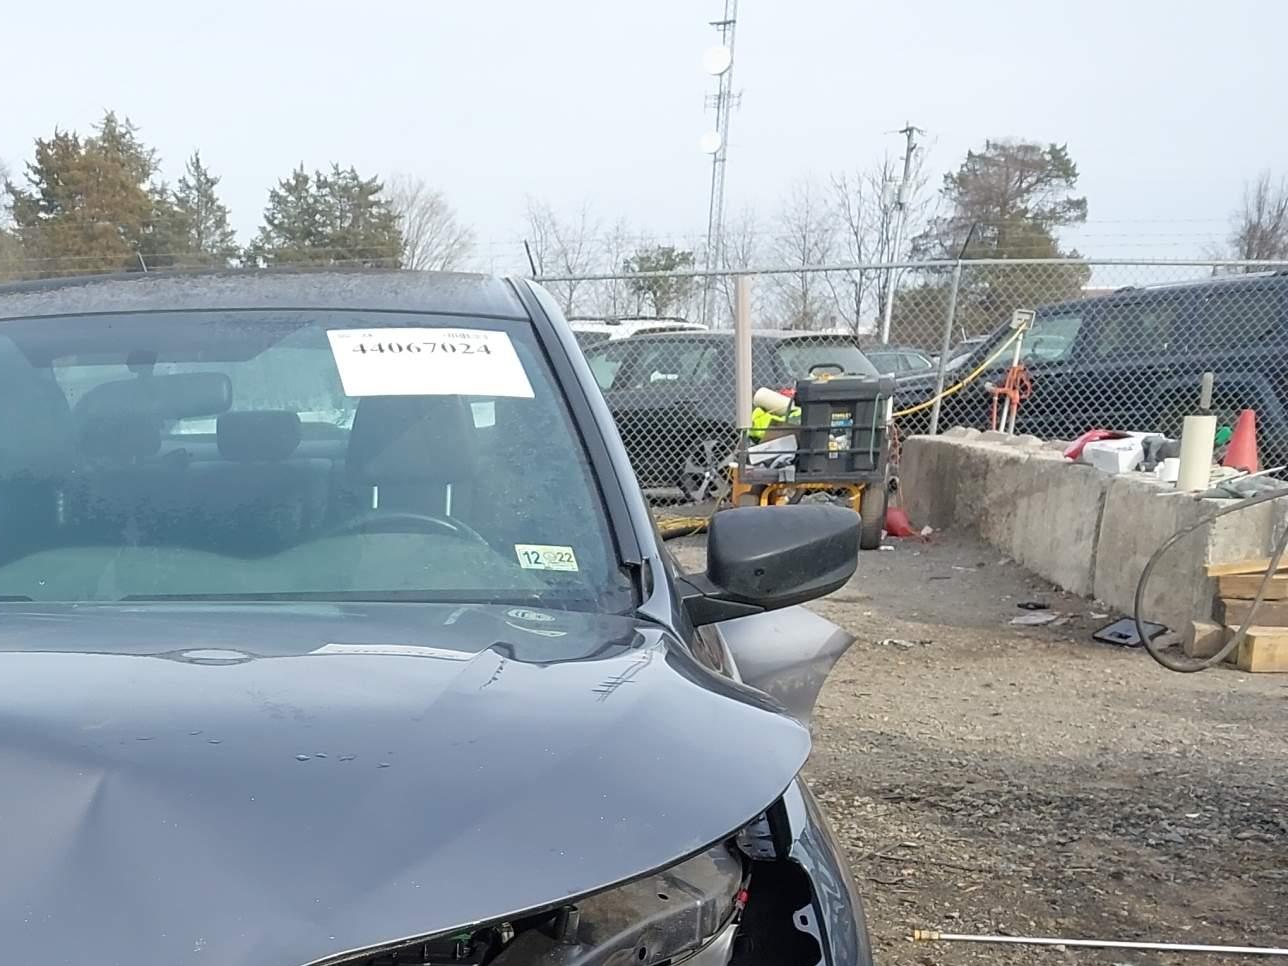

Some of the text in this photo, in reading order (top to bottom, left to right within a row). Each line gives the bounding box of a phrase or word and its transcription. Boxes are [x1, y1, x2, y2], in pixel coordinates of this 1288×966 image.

[352, 341, 492, 355] 44067024
[522, 550, 574, 565] 12 22
